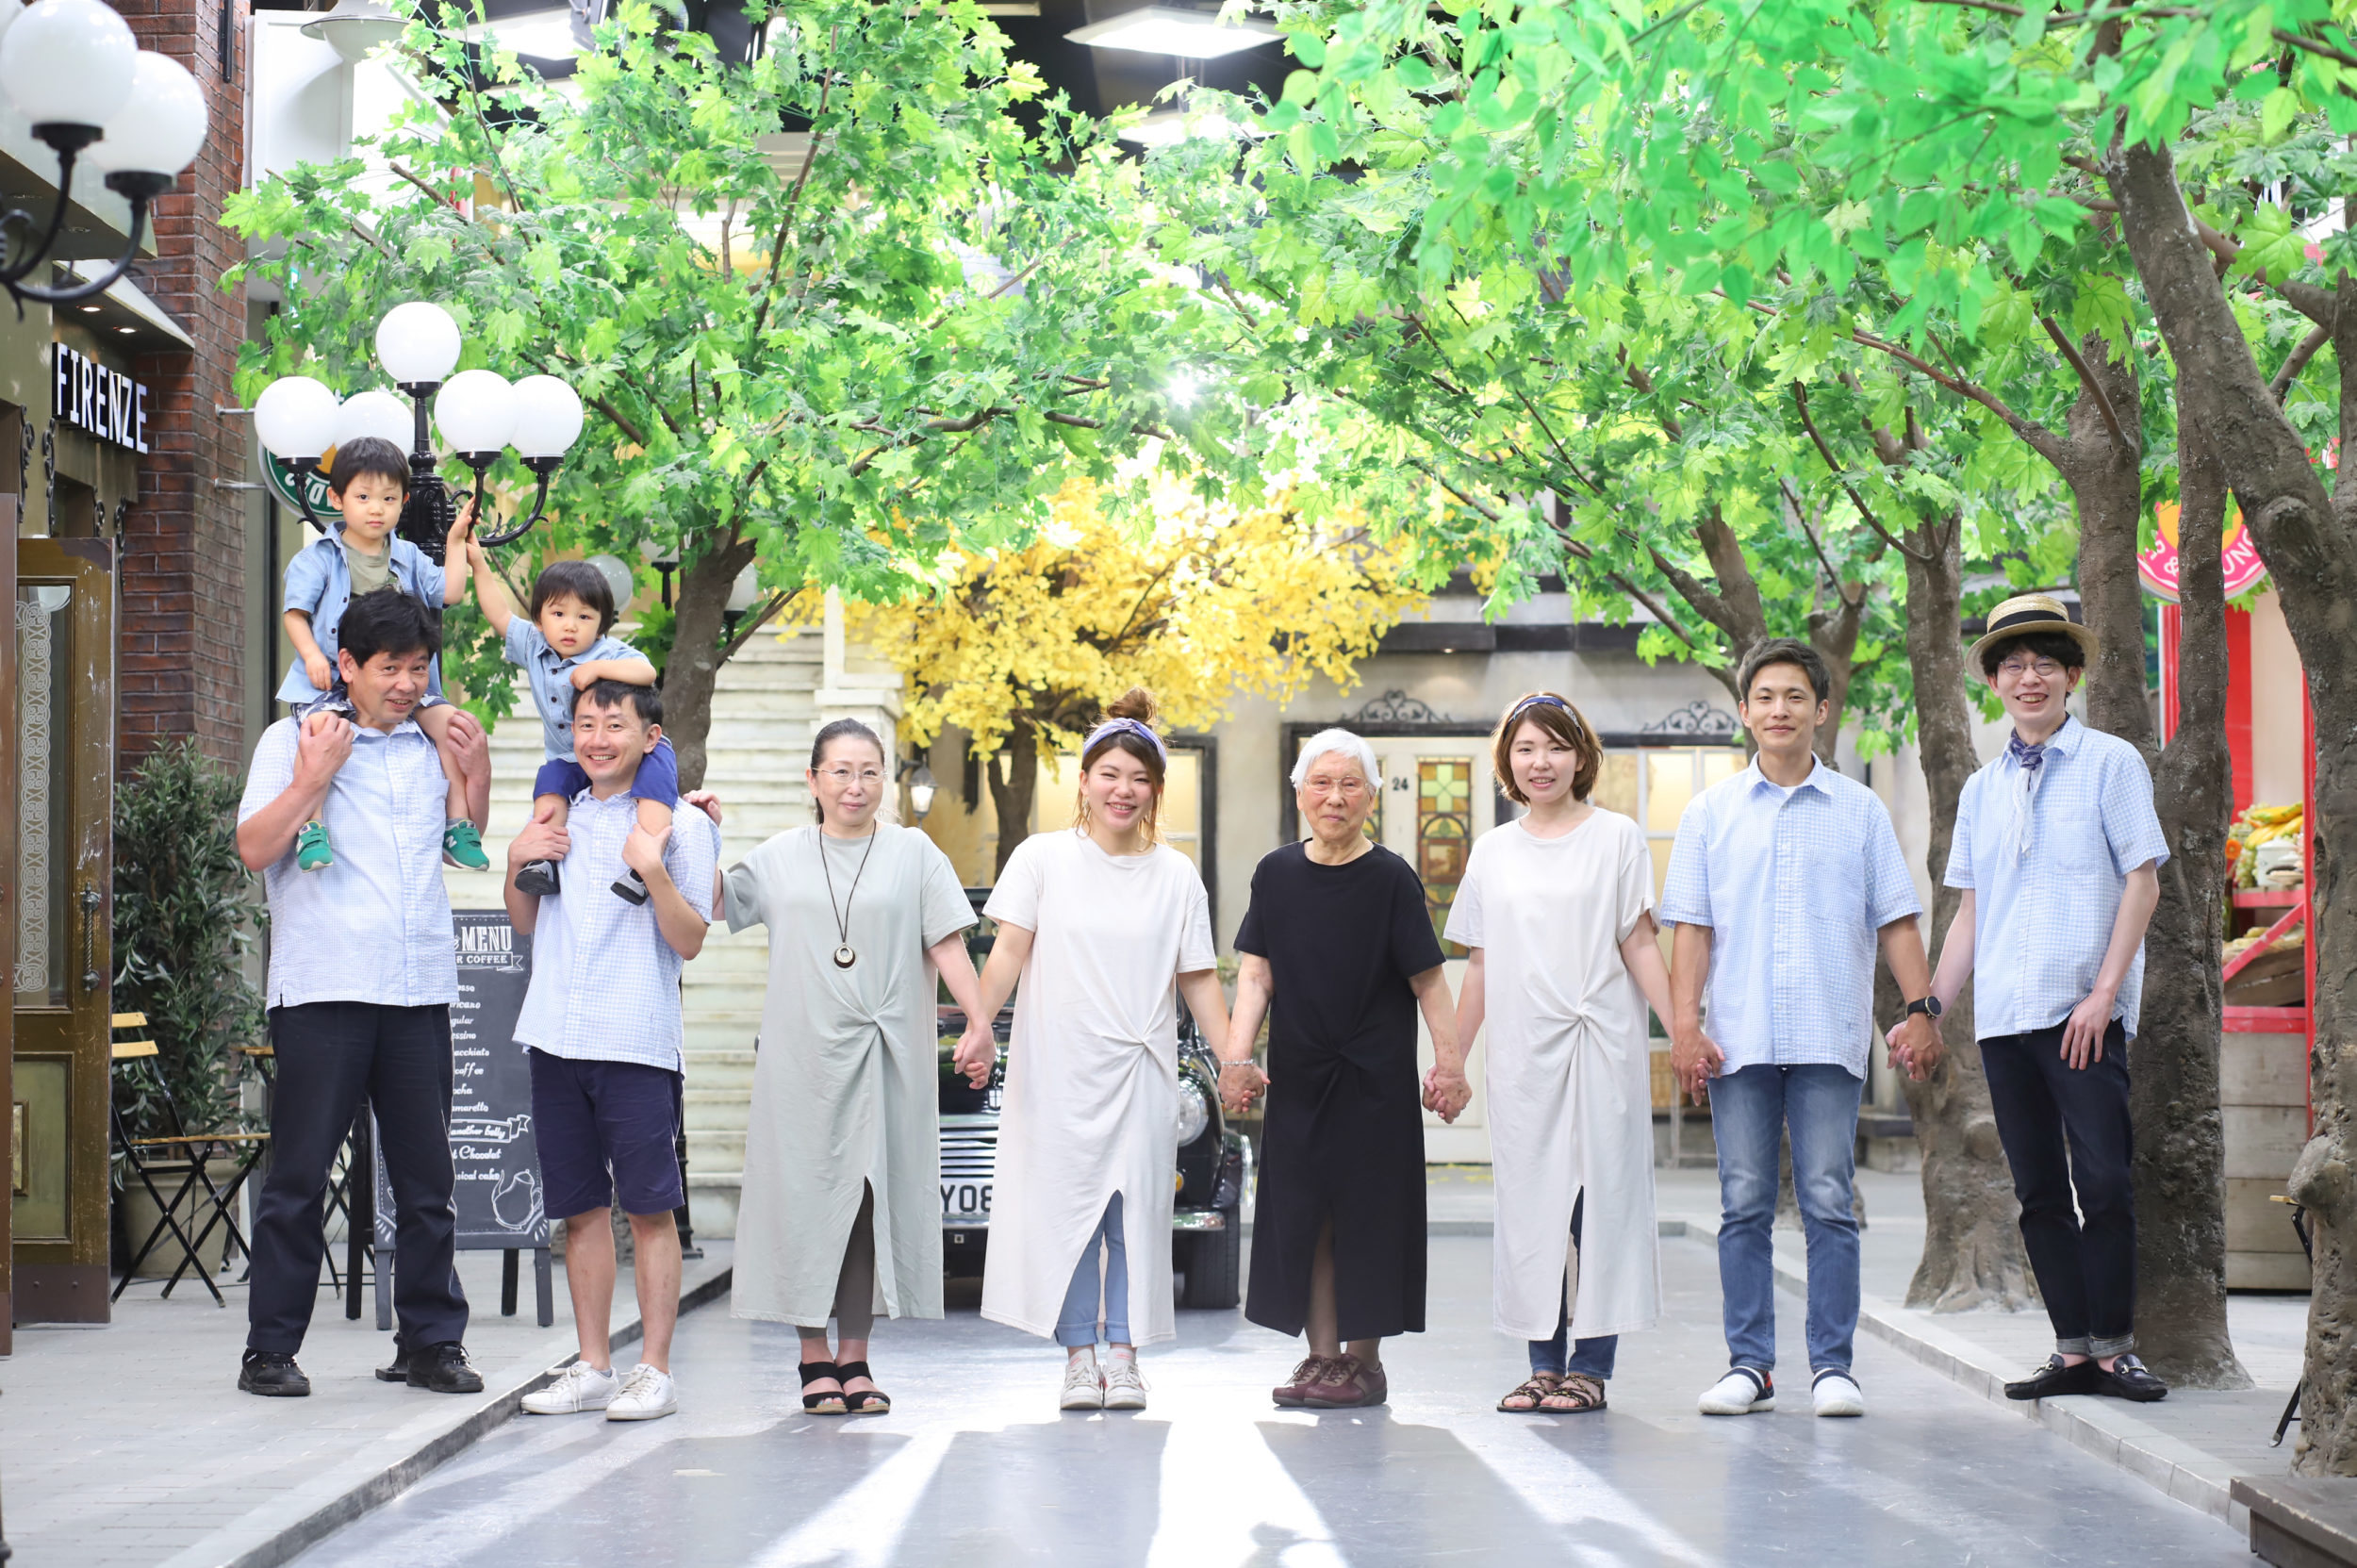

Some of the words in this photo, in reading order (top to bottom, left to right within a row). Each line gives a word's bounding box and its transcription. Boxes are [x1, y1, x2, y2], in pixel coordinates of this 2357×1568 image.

[55, 341, 148, 454] FIRENZE
[1392, 776, 1409, 791] 24
[461, 925, 513, 952] MENU
[466, 954, 508, 965] COFFEE
[454, 1062, 485, 1078] coffee
